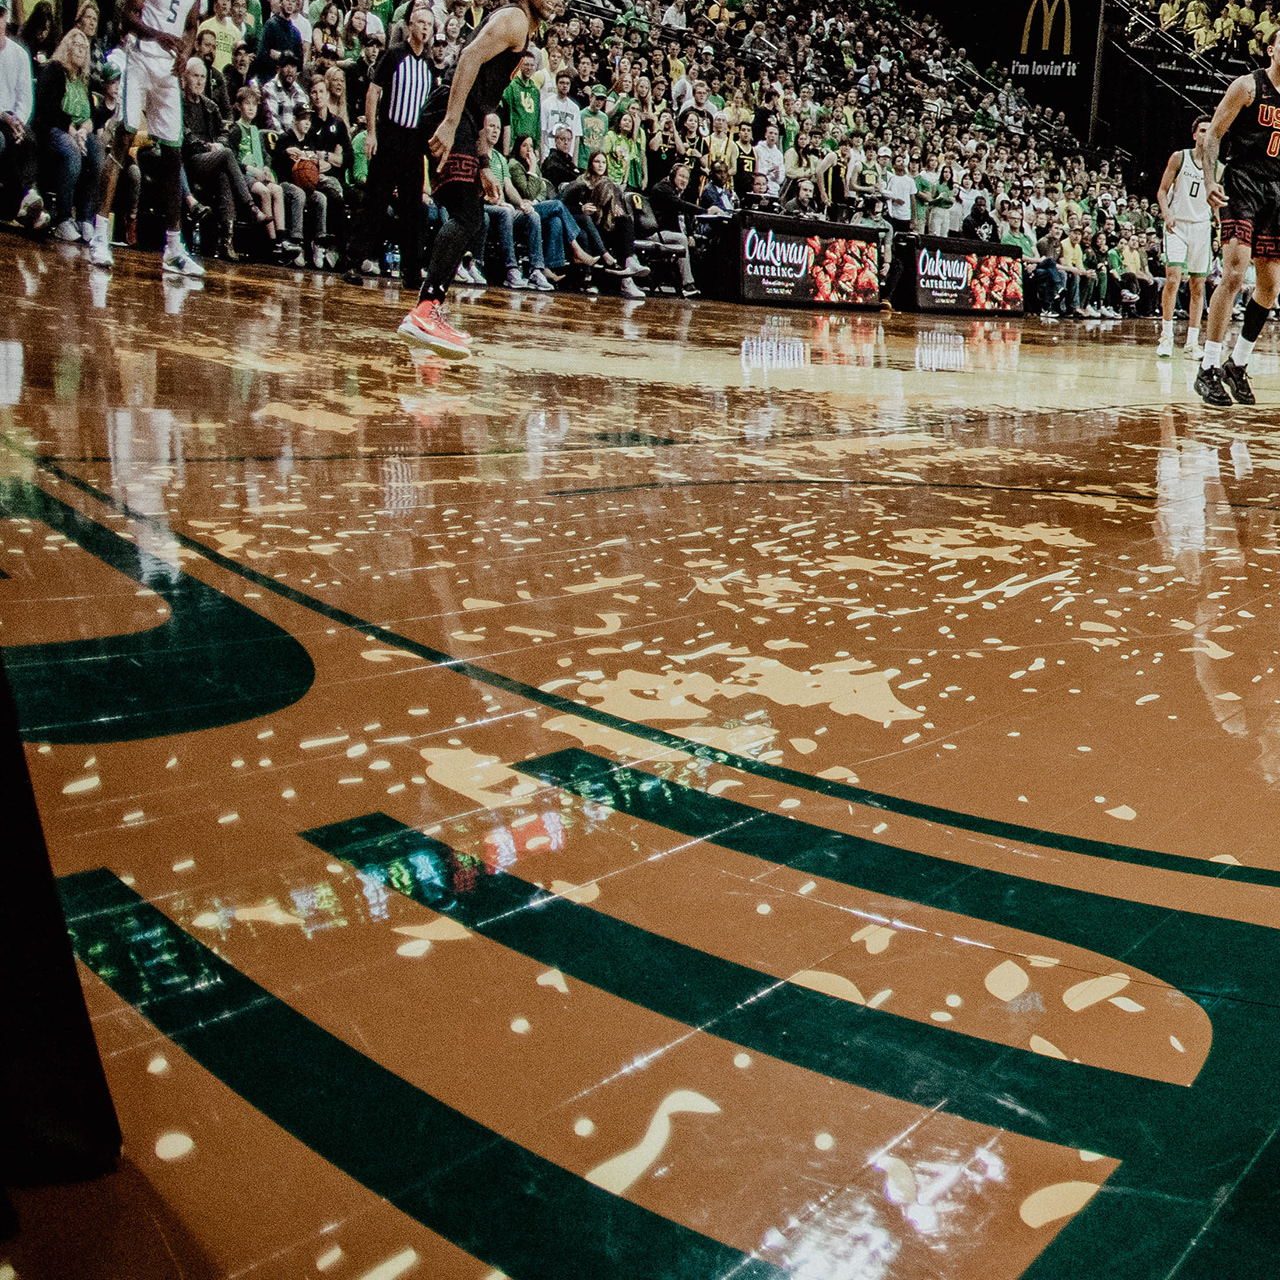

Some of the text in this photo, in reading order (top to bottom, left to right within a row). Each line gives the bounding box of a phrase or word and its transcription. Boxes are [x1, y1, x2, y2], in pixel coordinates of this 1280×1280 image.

[166, 0, 180, 24] 5
[744, 226, 809, 278] Oakway
[919, 248, 970, 290] Oakway
